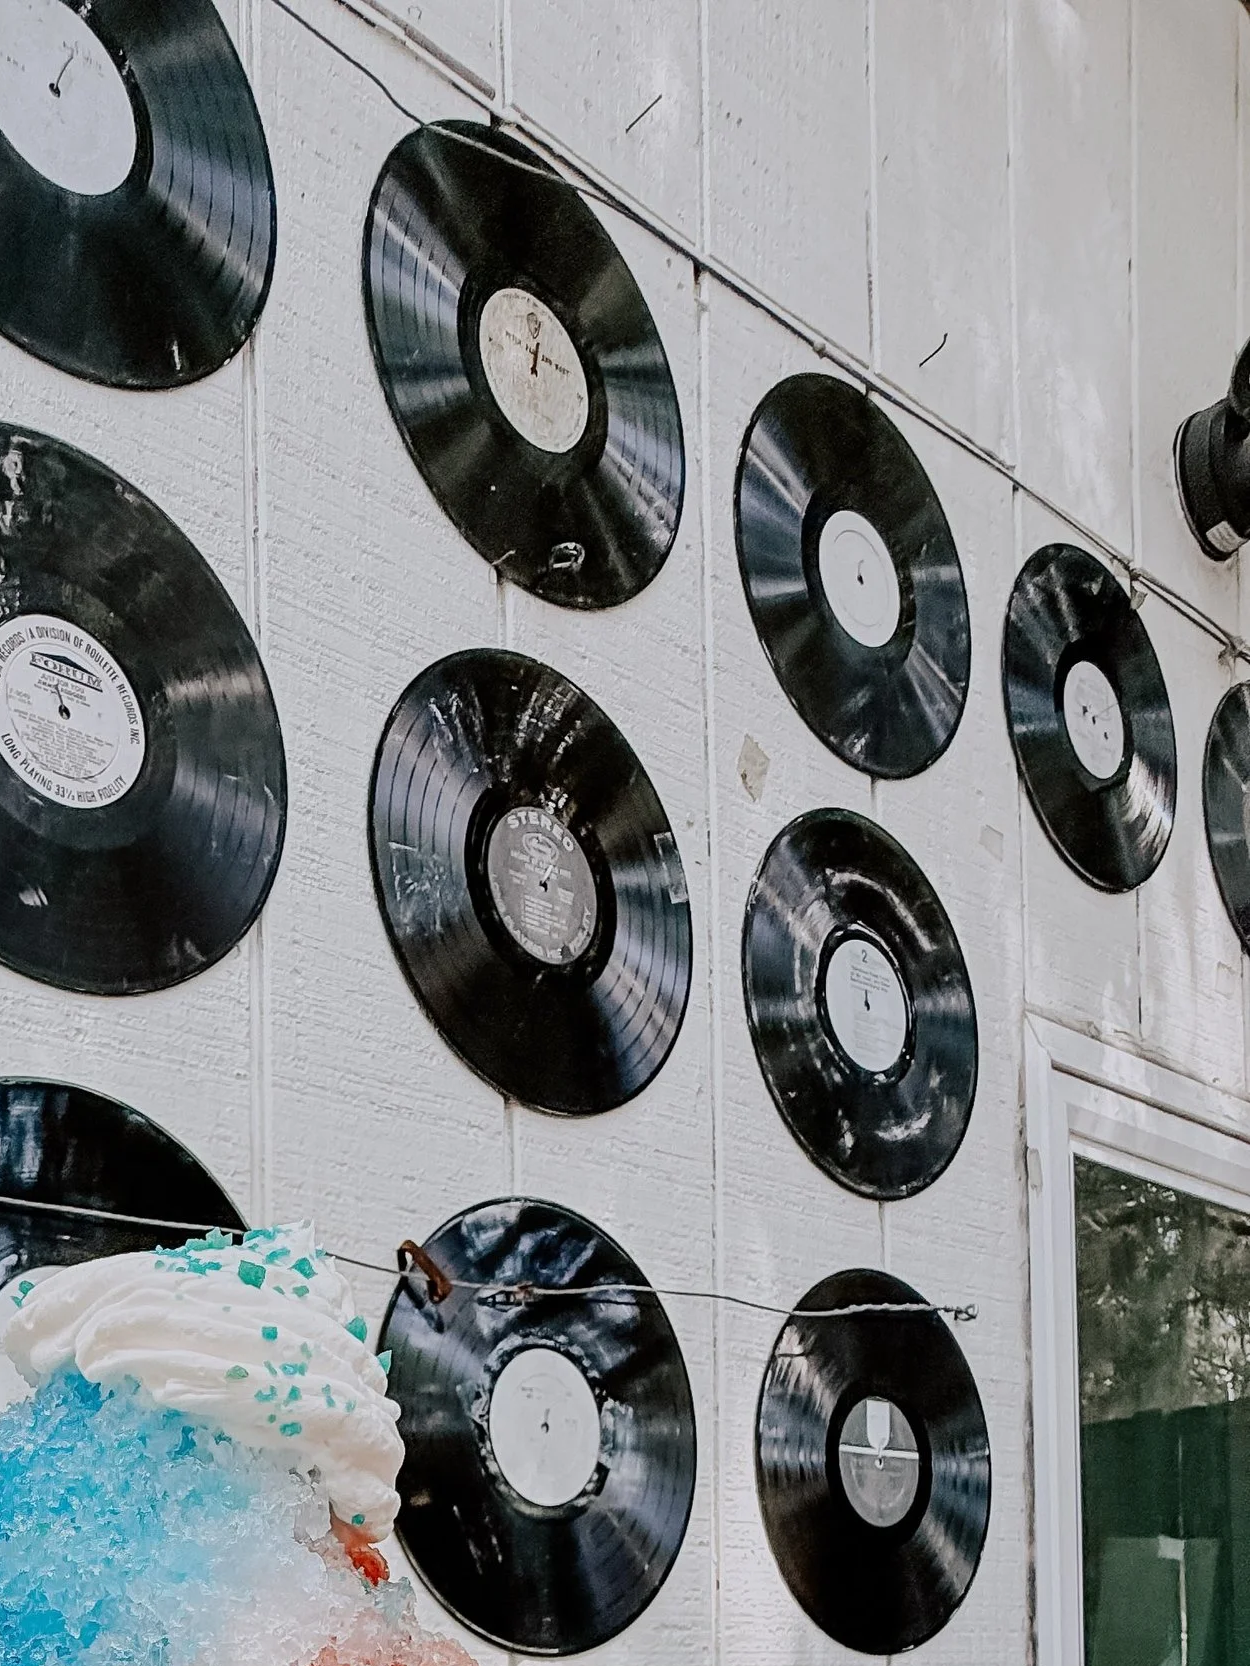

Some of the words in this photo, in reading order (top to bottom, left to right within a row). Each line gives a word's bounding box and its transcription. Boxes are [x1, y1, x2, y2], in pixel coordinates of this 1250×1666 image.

[31, 652, 103, 688] FORUM
[35, 626, 71, 644] DIVISION
[73, 635, 84, 650] OF
[84, 643, 119, 683] ROULETTE
[116, 682, 138, 726] RECORDS
[1, 733, 21, 760] LONG
[19, 758, 53, 792] PLAYING
[97, 775, 126, 801] FIDELITY
[506, 810, 575, 852] STEREO
[861, 949, 869, 963] 2
